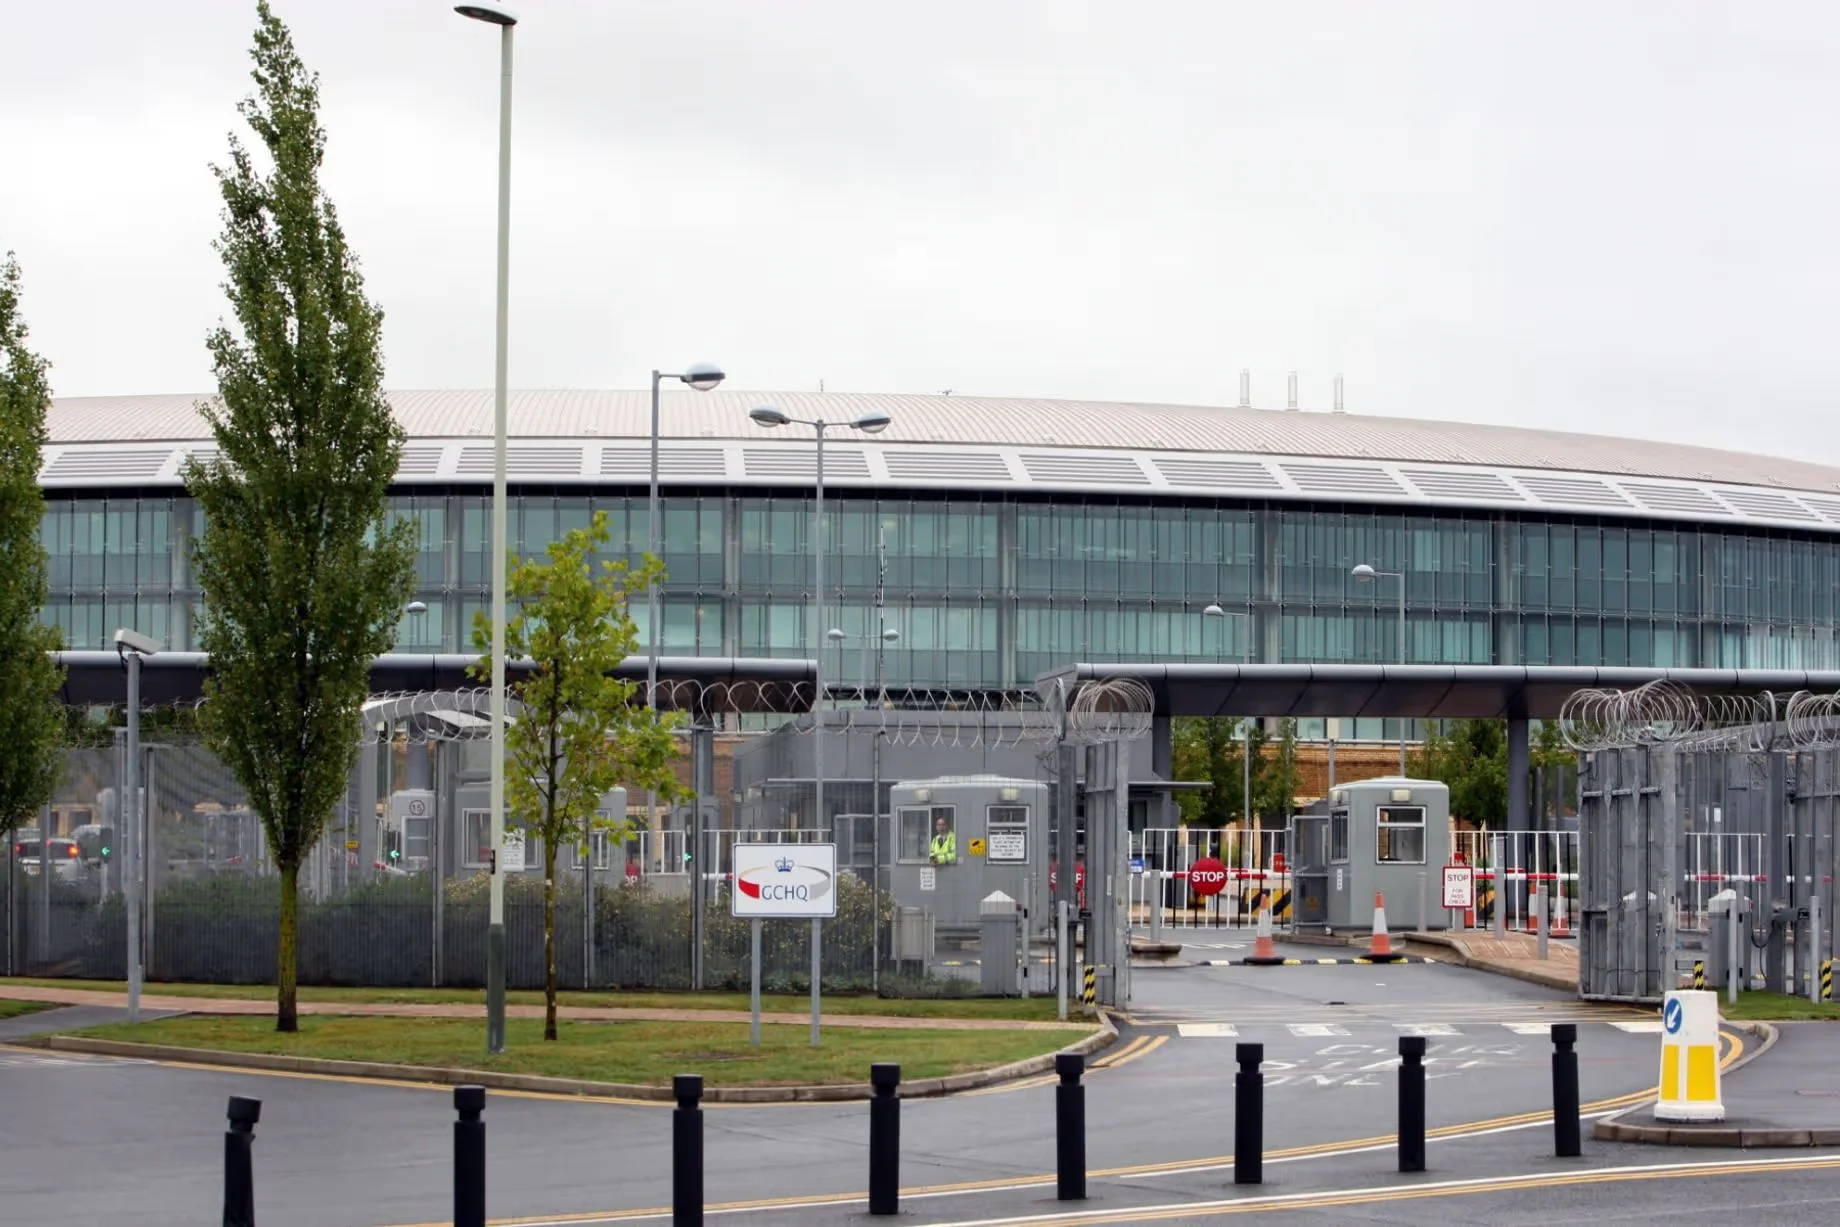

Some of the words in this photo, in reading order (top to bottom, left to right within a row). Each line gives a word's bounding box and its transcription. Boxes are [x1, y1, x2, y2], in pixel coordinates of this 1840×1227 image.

[1192, 871, 1225, 882] STOP
[1447, 874, 1469, 882] STOP
[761, 884, 808, 902] GCHQ
